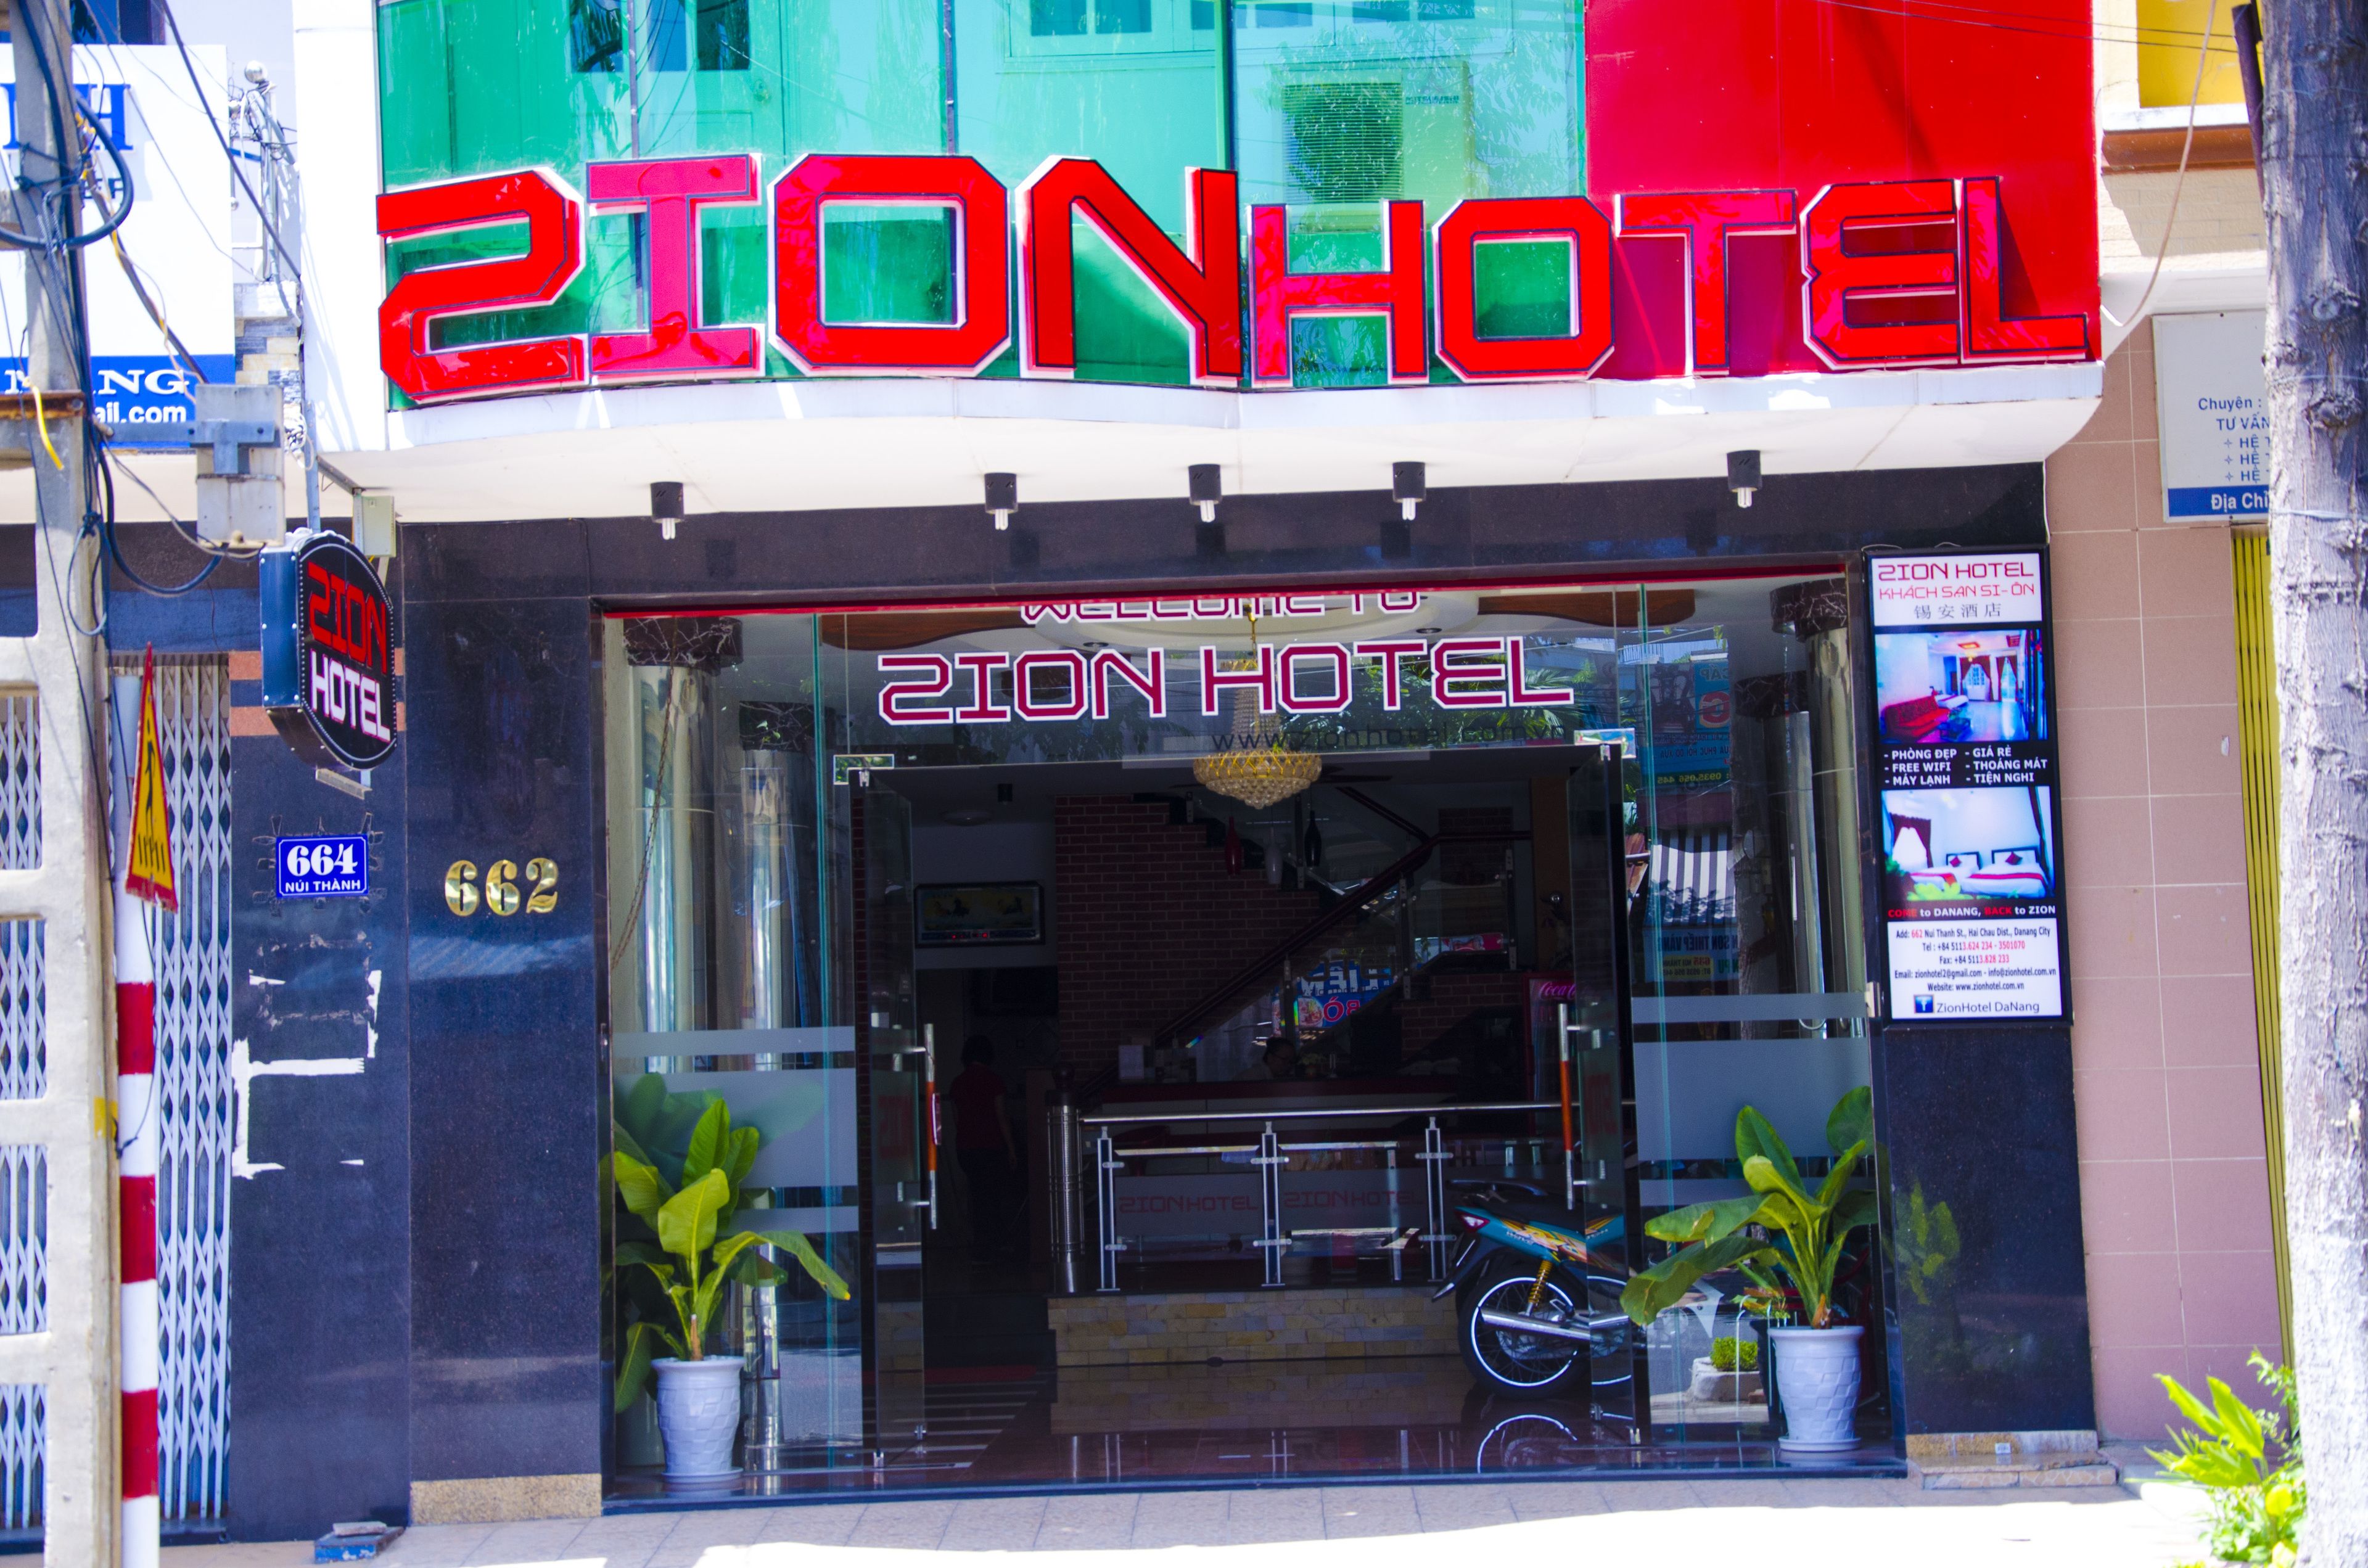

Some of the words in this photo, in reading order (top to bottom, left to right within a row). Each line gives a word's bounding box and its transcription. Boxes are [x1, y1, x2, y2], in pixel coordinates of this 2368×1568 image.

[376, 154, 1243, 404] ZION
[1248, 175, 2094, 385] HOTEL
[96, 401, 187, 424] ail.com
[2216, 416, 2237, 430] TƯ
[2211, 493, 2237, 513] Địa
[2242, 490, 2269, 509] Chỉ
[1878, 563, 1948, 581] ZION
[1956, 562, 2034, 578] HOTEL
[1880, 585, 1938, 600] KHÁCH
[1942, 585, 1976, 598] SẠN
[1914, 602, 2002, 619] 锡安酒店
[308, 562, 387, 675] ZION
[878, 646, 1167, 726] ZION
[1199, 636, 1574, 717] HOTEL
[310, 648, 391, 744] HOTEL
[1891, 747, 1932, 760] PHÒNG
[1934, 749, 1957, 760] ĐẸP
[1973, 744, 1994, 758] GIÁ
[1892, 762, 1920, 773] FREE
[1923, 761, 1951, 772] WIFI
[1973, 757, 2021, 770] THOÁNG
[2024, 756, 2047, 769] MÁT
[1893, 773, 1917, 786] MÁY
[1920, 774, 1951, 787] LẠNH
[1973, 770, 2001, 785] TIỆN
[2004, 772, 2034, 783] NGHI
[287, 844, 358, 877] 664
[285, 879, 309, 892] NÚI
[313, 878, 361, 892] THÀNH
[445, 858, 558, 916] 662
[1888, 908, 1917, 918] COME
[1919, 908, 1931, 917] to
[1933, 907, 1981, 917] DANANG,
[1984, 906, 2013, 916] BACK
[2015, 906, 2026, 915] to
[2028, 905, 2056, 914] ZION
[1896, 929, 1910, 938] Add:
[1911, 929, 1923, 938] 662
[1925, 929, 1935, 938] Nui
[1936, 929, 1955, 937] Thanh
[1968, 927, 1979, 937] Hai
[1980, 927, 1995, 937] Chau
[2014, 927, 2037, 938] Danang
[2039, 926, 2051, 937] City
[1938, 942, 1949, 951] +84
[1981, 941, 1993, 950] 234
[1939, 956, 1953, 965] Fax:
[1954, 955, 1967, 964] +84
[1998, 954, 2010, 963] 233
[1894, 969, 1914, 979] Email:
[1928, 982, 1954, 992] Website:
[1936, 1002, 1992, 1014] ZionHotel
[1995, 1001, 2040, 1014] DaNang
